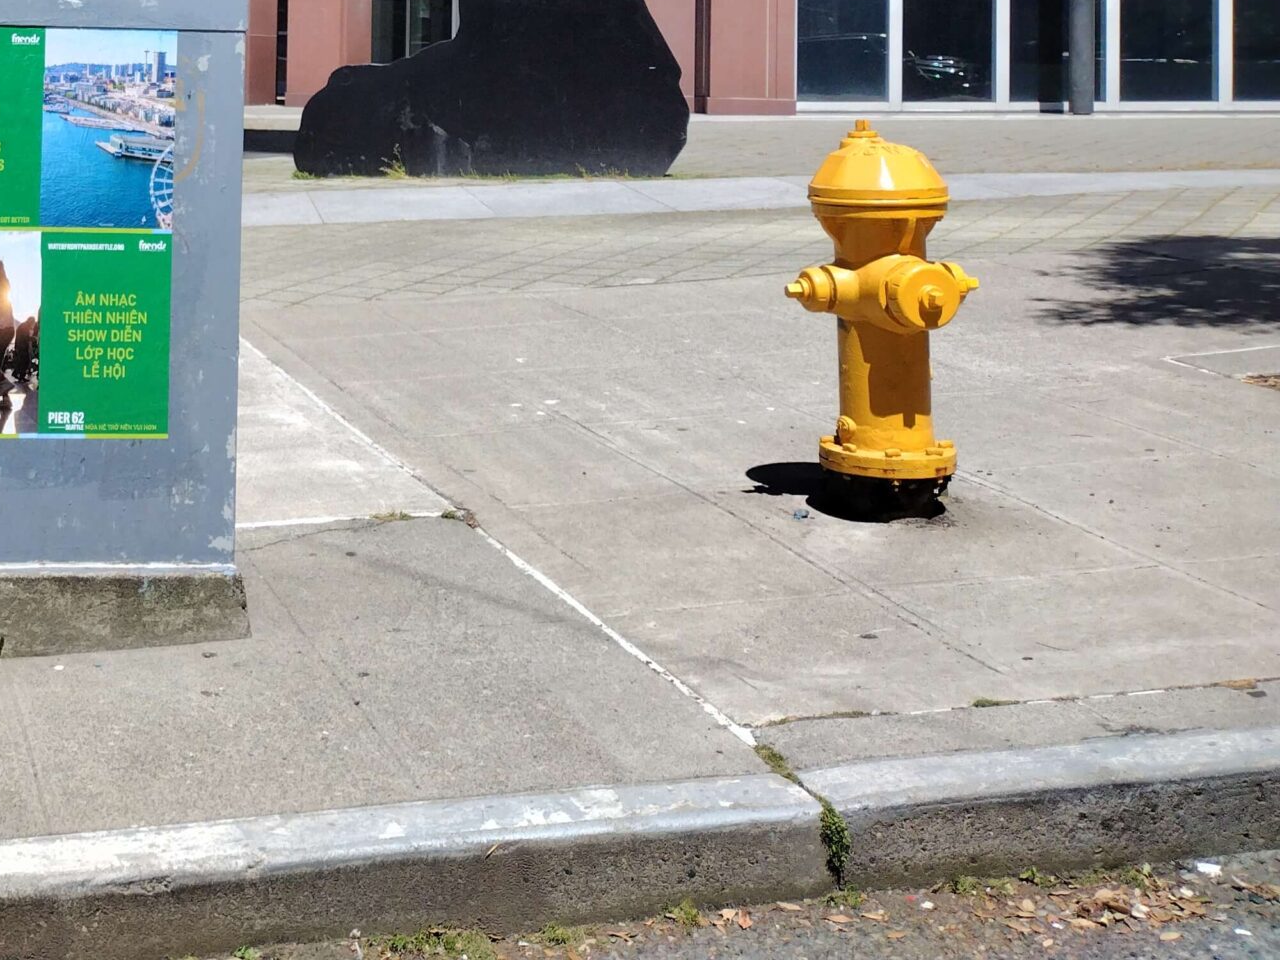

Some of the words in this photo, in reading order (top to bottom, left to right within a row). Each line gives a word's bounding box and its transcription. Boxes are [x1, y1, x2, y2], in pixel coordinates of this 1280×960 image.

[75, 291, 96, 306] ÂM
[100, 293, 137, 308] NHẠC
[63, 309, 103, 324] THIÊN
[106, 309, 148, 324] NHIÊN
[67, 329, 107, 342] SHOW
[111, 325, 142, 342] DIỄN
[76, 345, 104, 360] LỚP
[107, 347, 134, 362] HỌC
[103, 363, 126, 380] HỘI
[48, 412, 70, 424] PIER
[71, 412, 85, 424] 62
